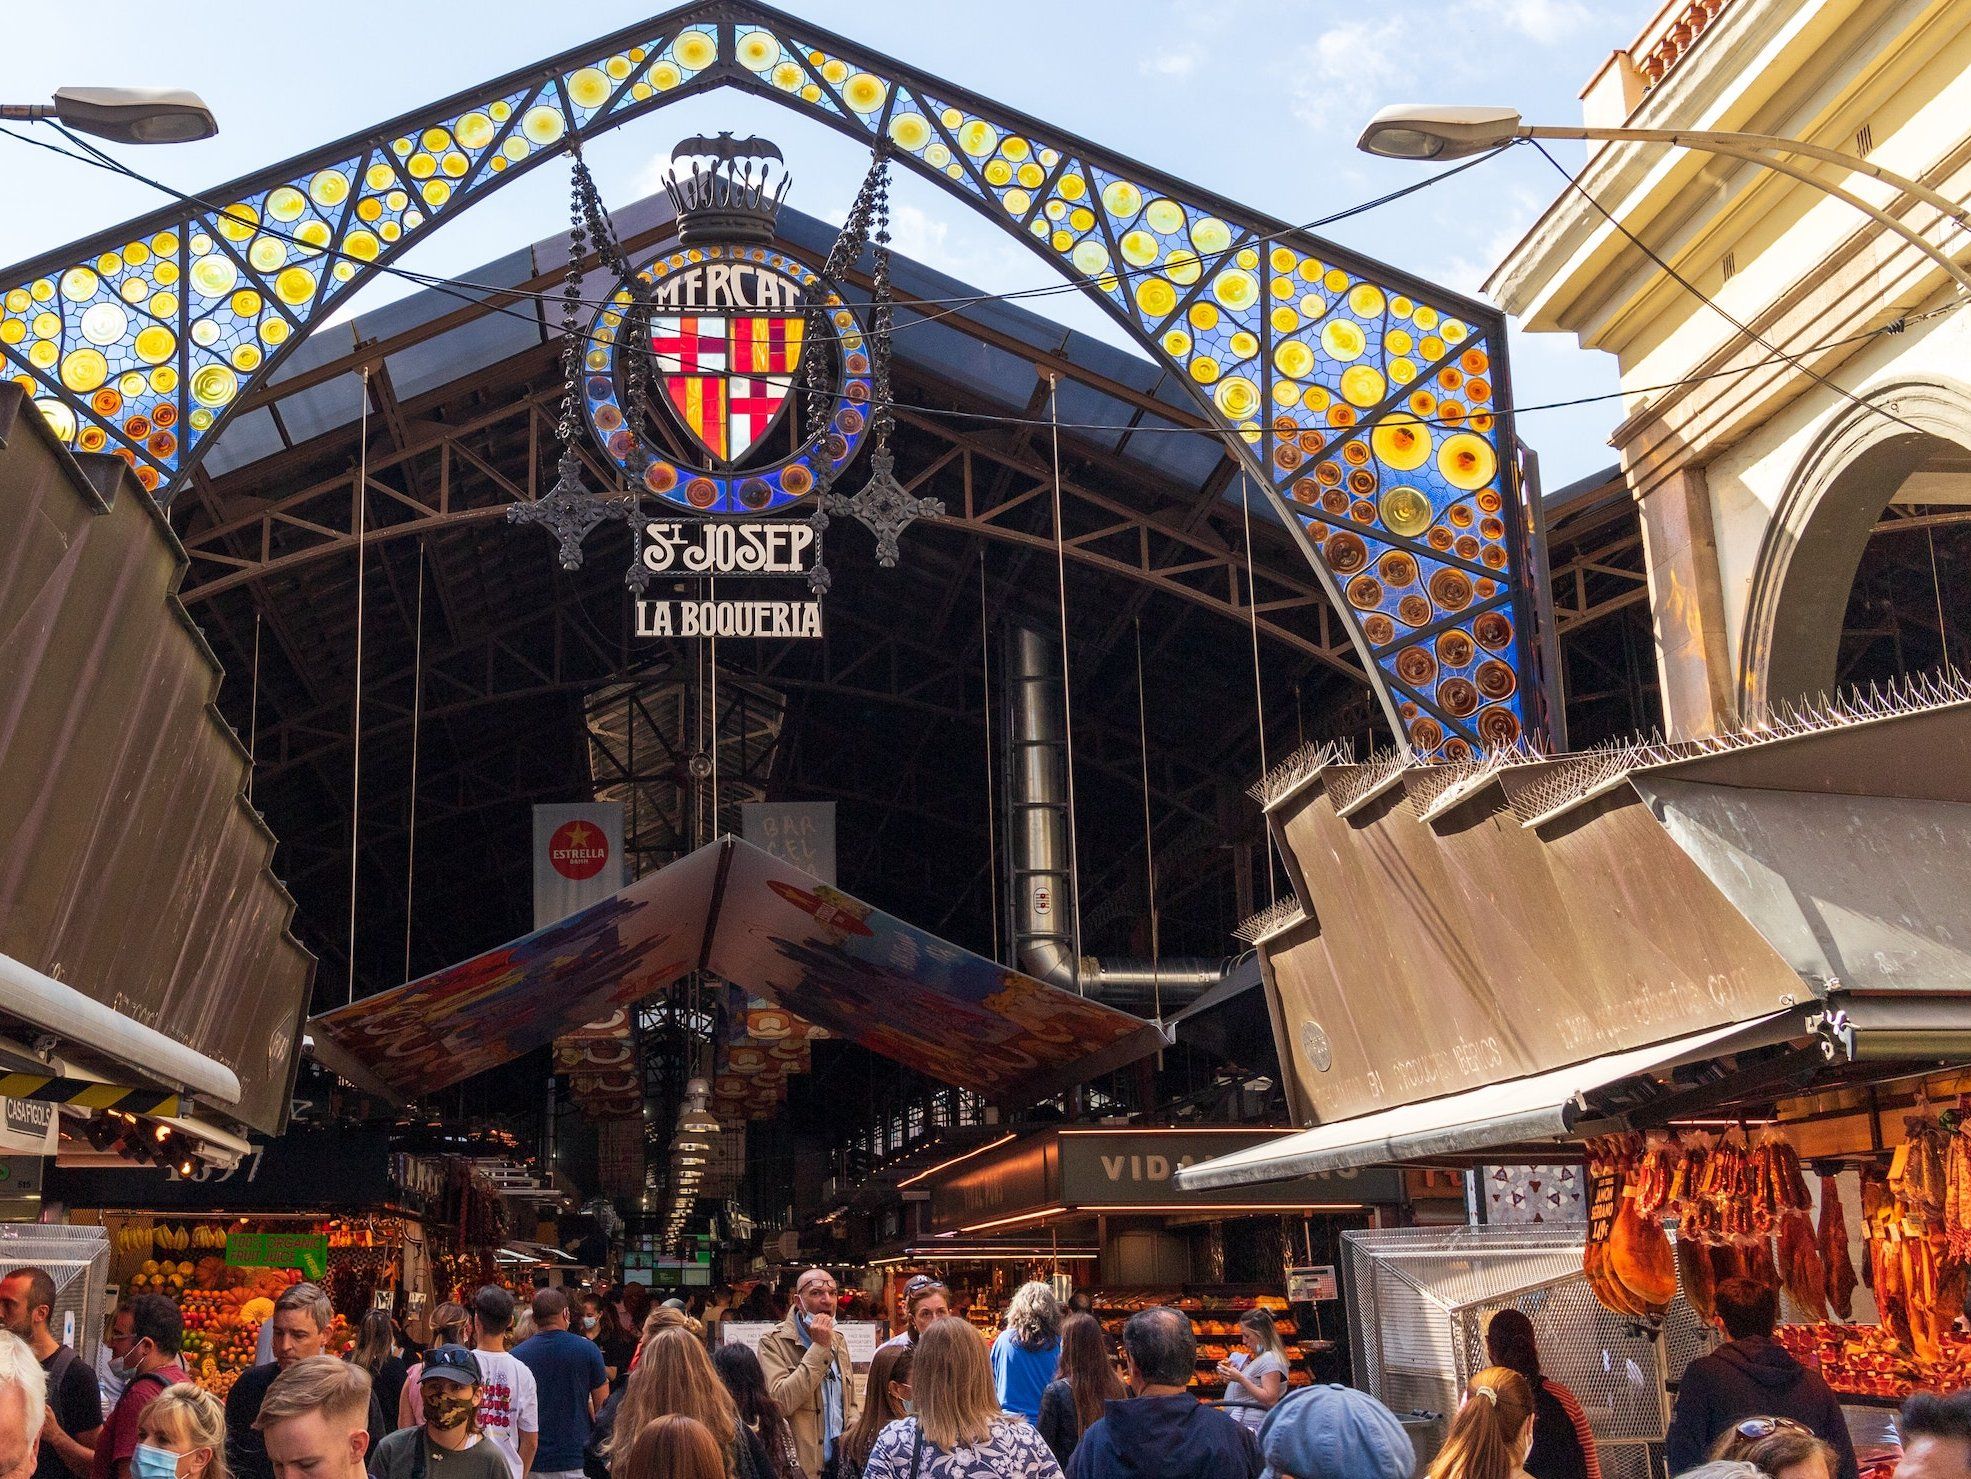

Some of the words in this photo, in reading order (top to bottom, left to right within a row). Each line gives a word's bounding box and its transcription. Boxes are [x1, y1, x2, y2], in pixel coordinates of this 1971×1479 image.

[655, 263, 801, 313] MERCAT
[682, 523, 814, 572] JOSEP
[636, 601, 673, 637] LA
[680, 601, 823, 637] BOQUERIA
[552, 848, 605, 859] ESTRELLA
[7, 1098, 26, 1122] CASA
[265, 1235, 322, 1250] ORGANIC
[229, 1250, 262, 1262] FRUIT
[263, 1250, 296, 1263] JUICE
